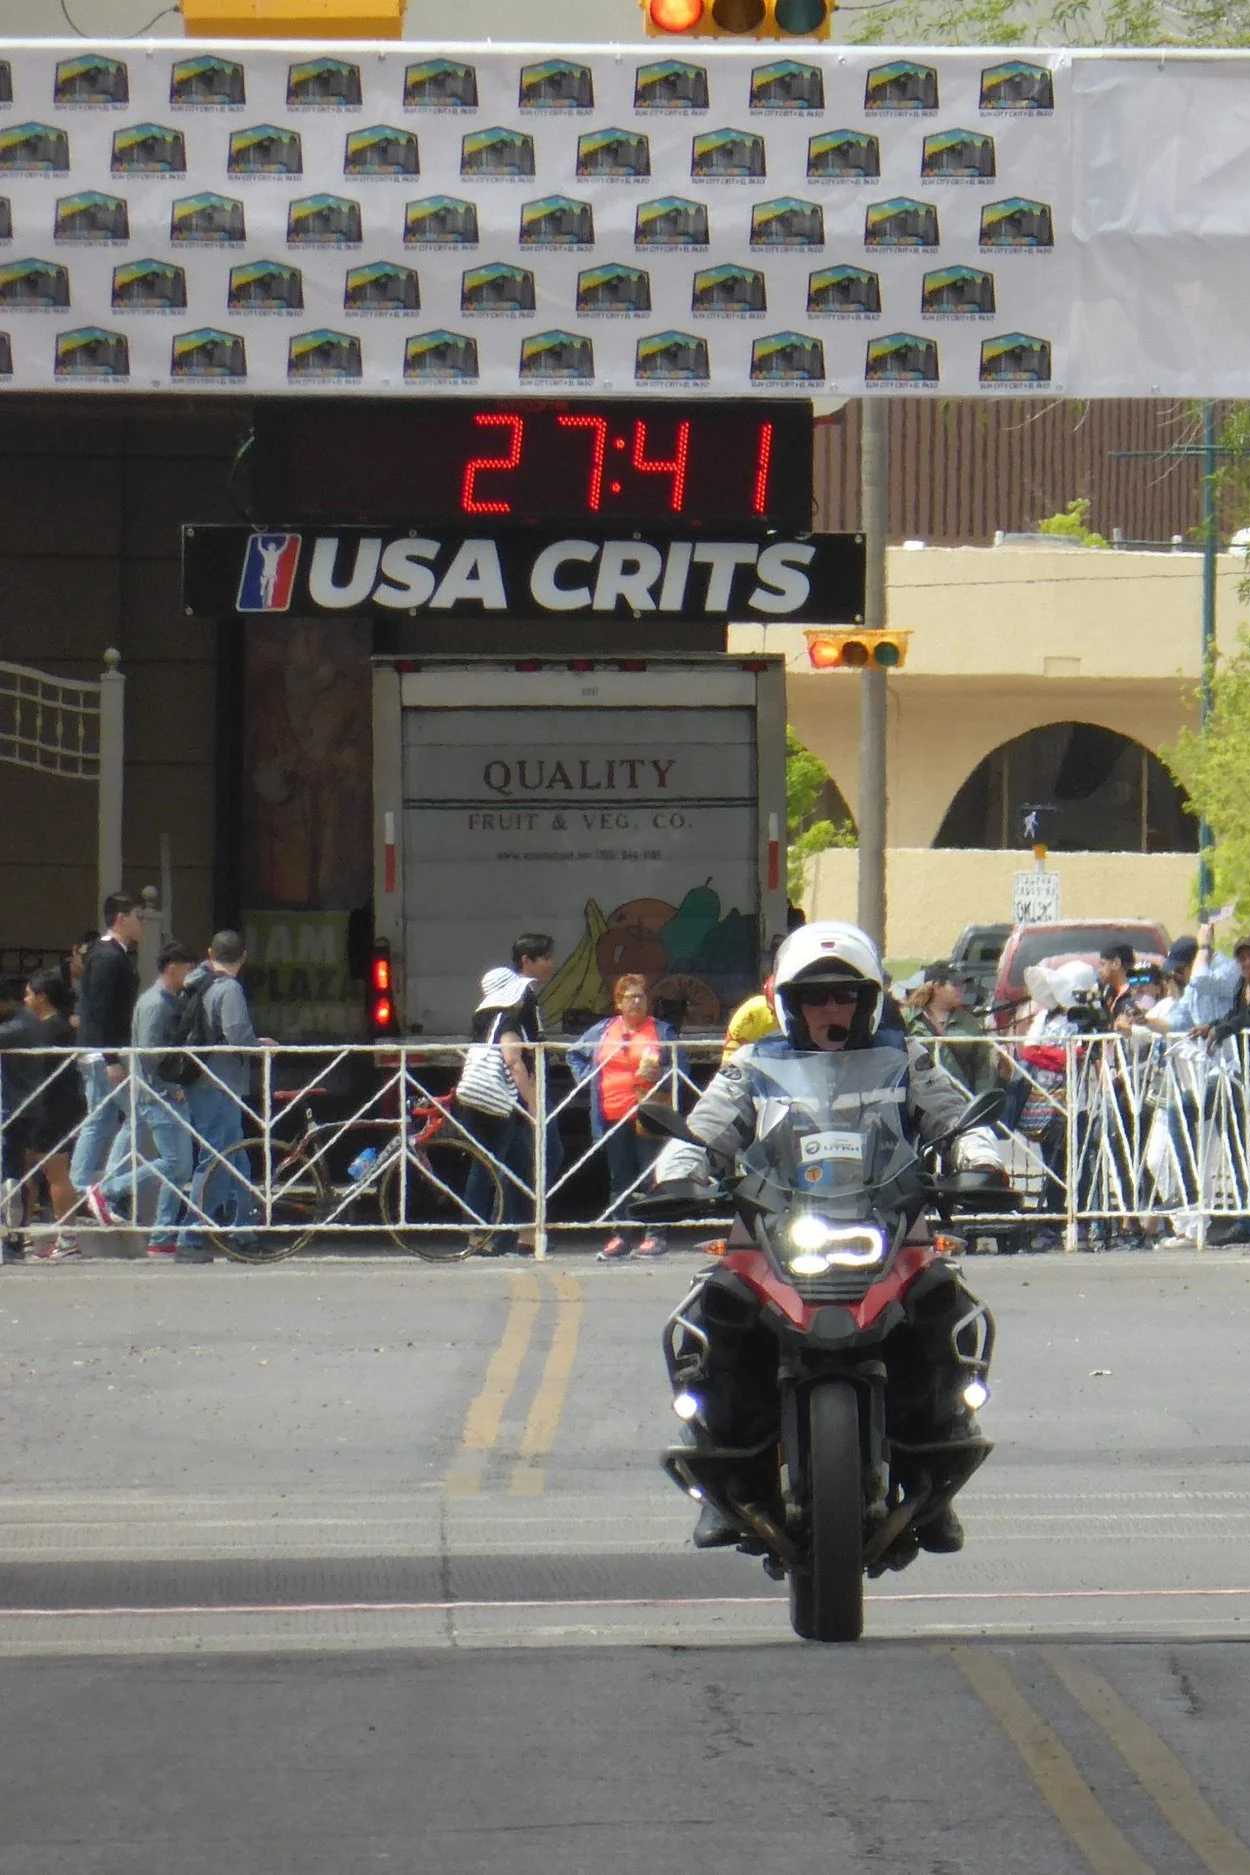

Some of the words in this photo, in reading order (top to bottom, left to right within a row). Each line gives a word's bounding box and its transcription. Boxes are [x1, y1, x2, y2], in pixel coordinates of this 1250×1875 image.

[308, 537, 507, 611] USA
[530, 539, 816, 613] CRITS
[483, 759, 676, 796] QUALITY
[467, 813, 539, 831] FRUIT
[552, 813, 568, 831] &
[583, 812, 639, 831] VEG.
[652, 812, 693, 830] CO.
